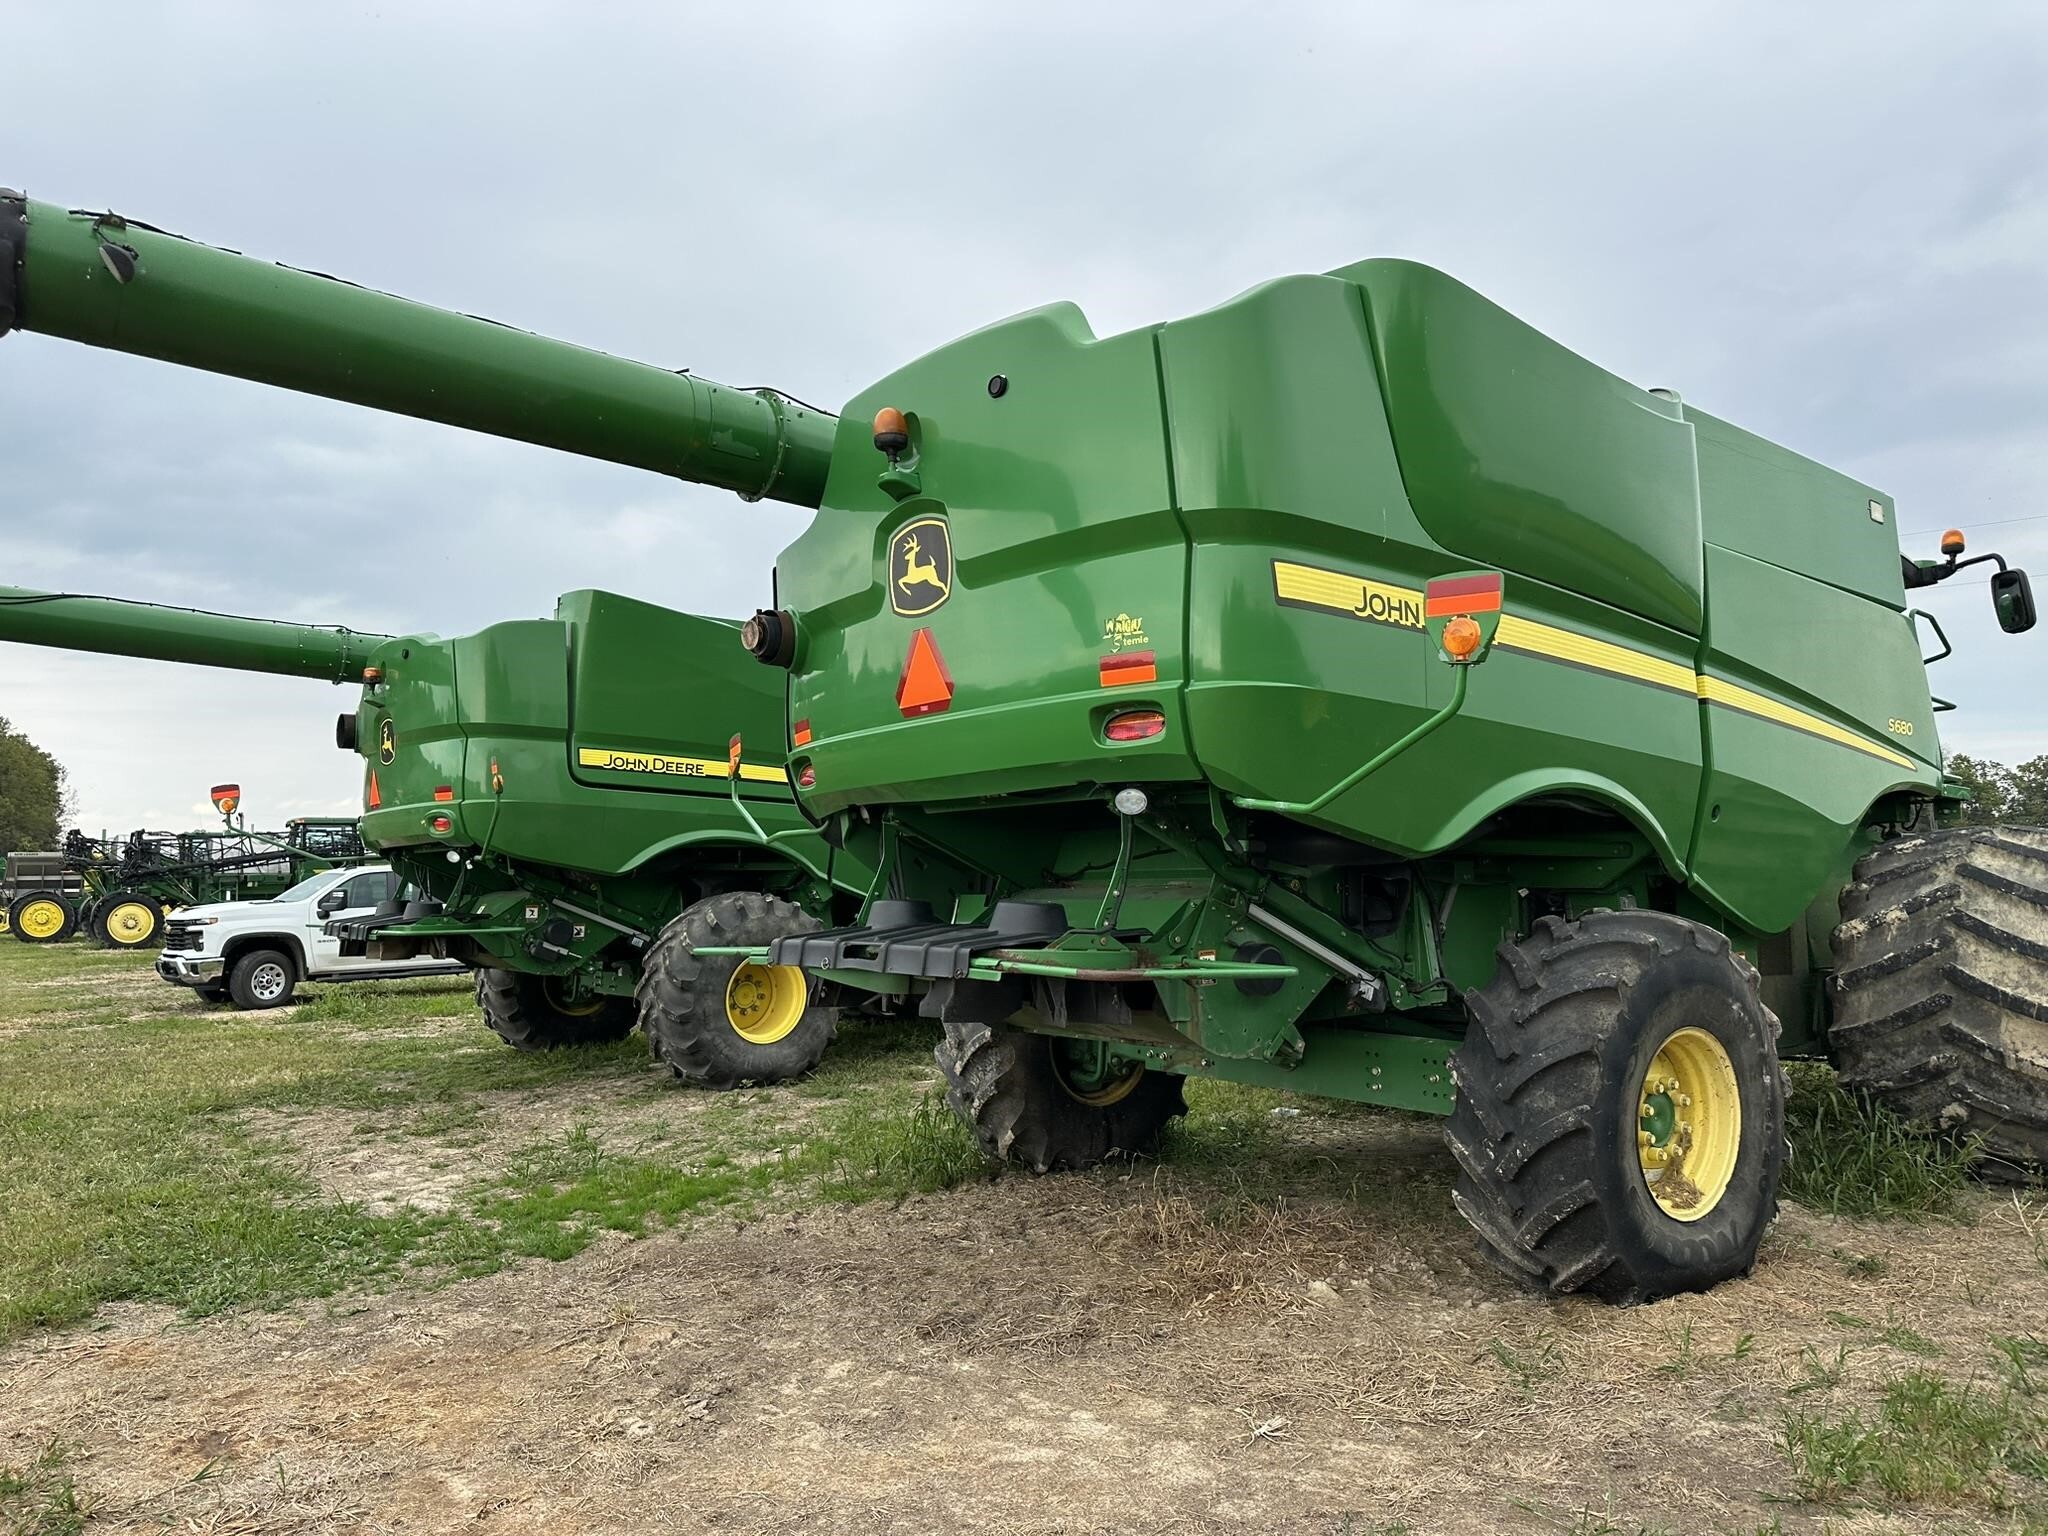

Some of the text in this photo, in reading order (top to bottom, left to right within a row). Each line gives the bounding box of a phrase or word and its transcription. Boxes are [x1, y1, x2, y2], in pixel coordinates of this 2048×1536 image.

[1354, 586, 1420, 625] JOHN
[1888, 718, 1913, 736] S680
[603, 754, 705, 775] JOHN DEERE
